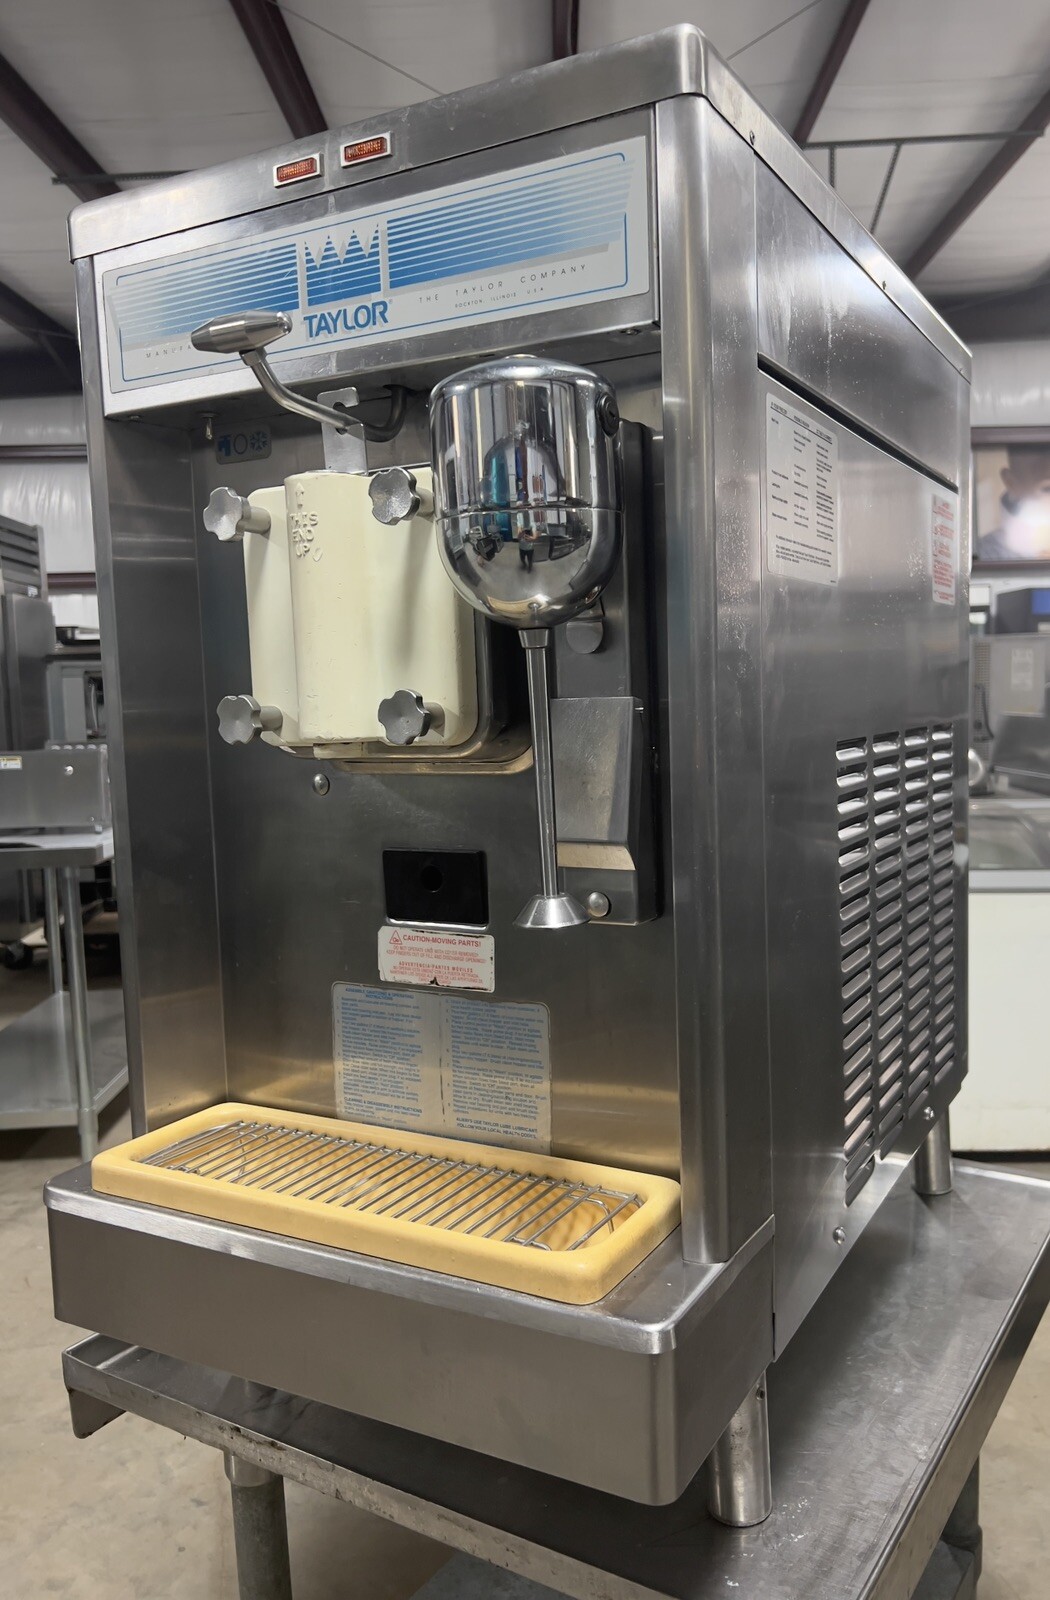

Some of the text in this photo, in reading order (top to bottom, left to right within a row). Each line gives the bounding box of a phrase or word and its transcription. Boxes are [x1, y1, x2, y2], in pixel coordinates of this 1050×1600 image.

[419, 264, 586, 303] THE TAYLOR COMPANY
[303, 300, 389, 338] TAYLOR
[292, 528, 315, 543] END
